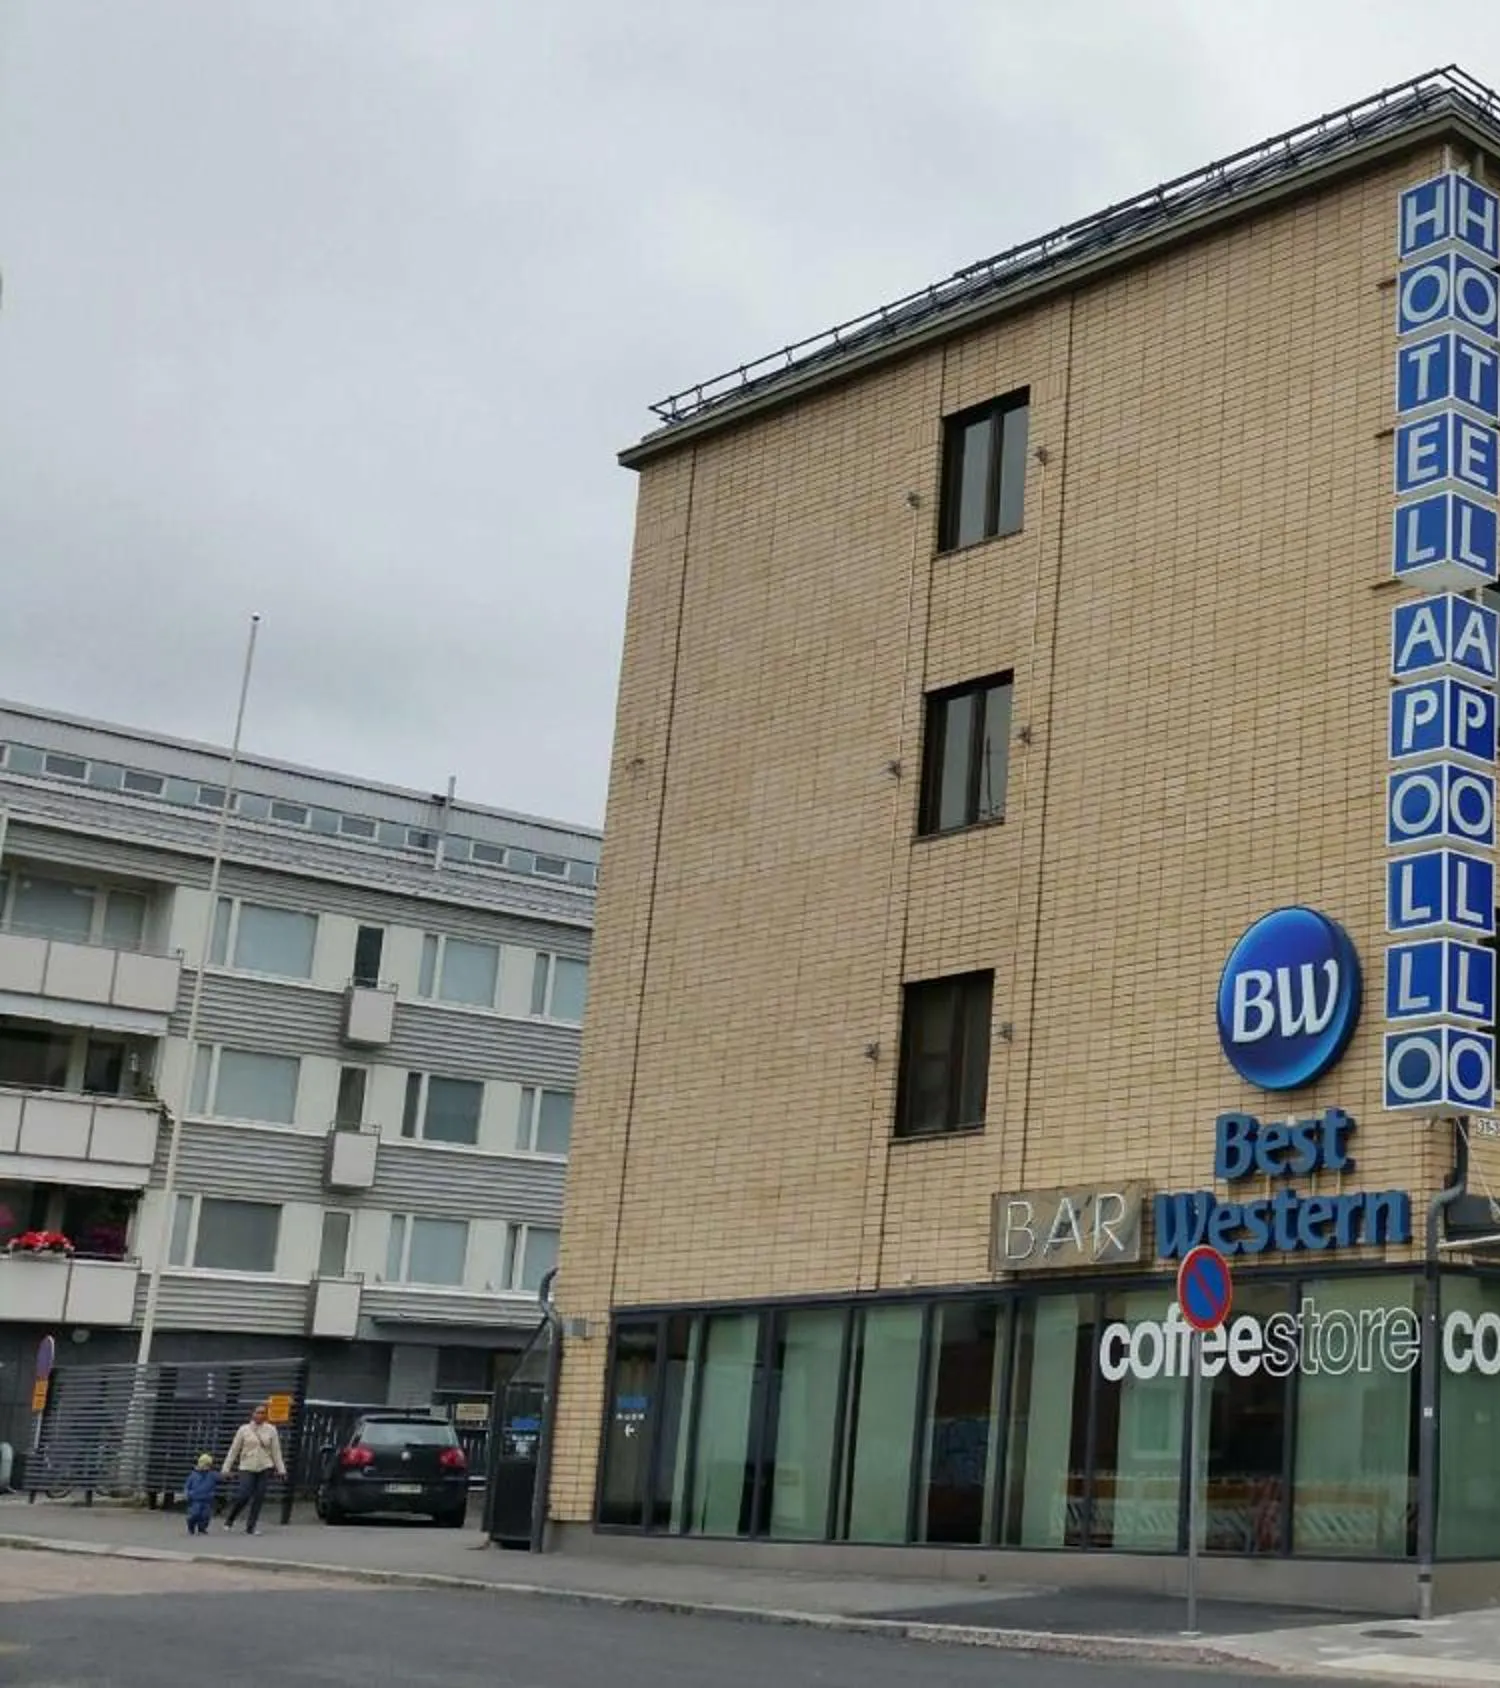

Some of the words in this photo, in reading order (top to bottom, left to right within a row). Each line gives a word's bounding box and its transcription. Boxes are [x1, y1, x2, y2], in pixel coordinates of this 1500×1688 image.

[1402, 184, 1449, 564] HOTEL
[1456, 180, 1497, 568] HOTEL
[1389, 606, 1445, 1099] APOLLO
[1449, 611, 1493, 1099] APOLLO
[1232, 958, 1340, 1044] BW
[1005, 1193, 1125, 1259] BAR
[1154, 1187, 1413, 1258] Western
[1214, 1107, 1355, 1182] Best
